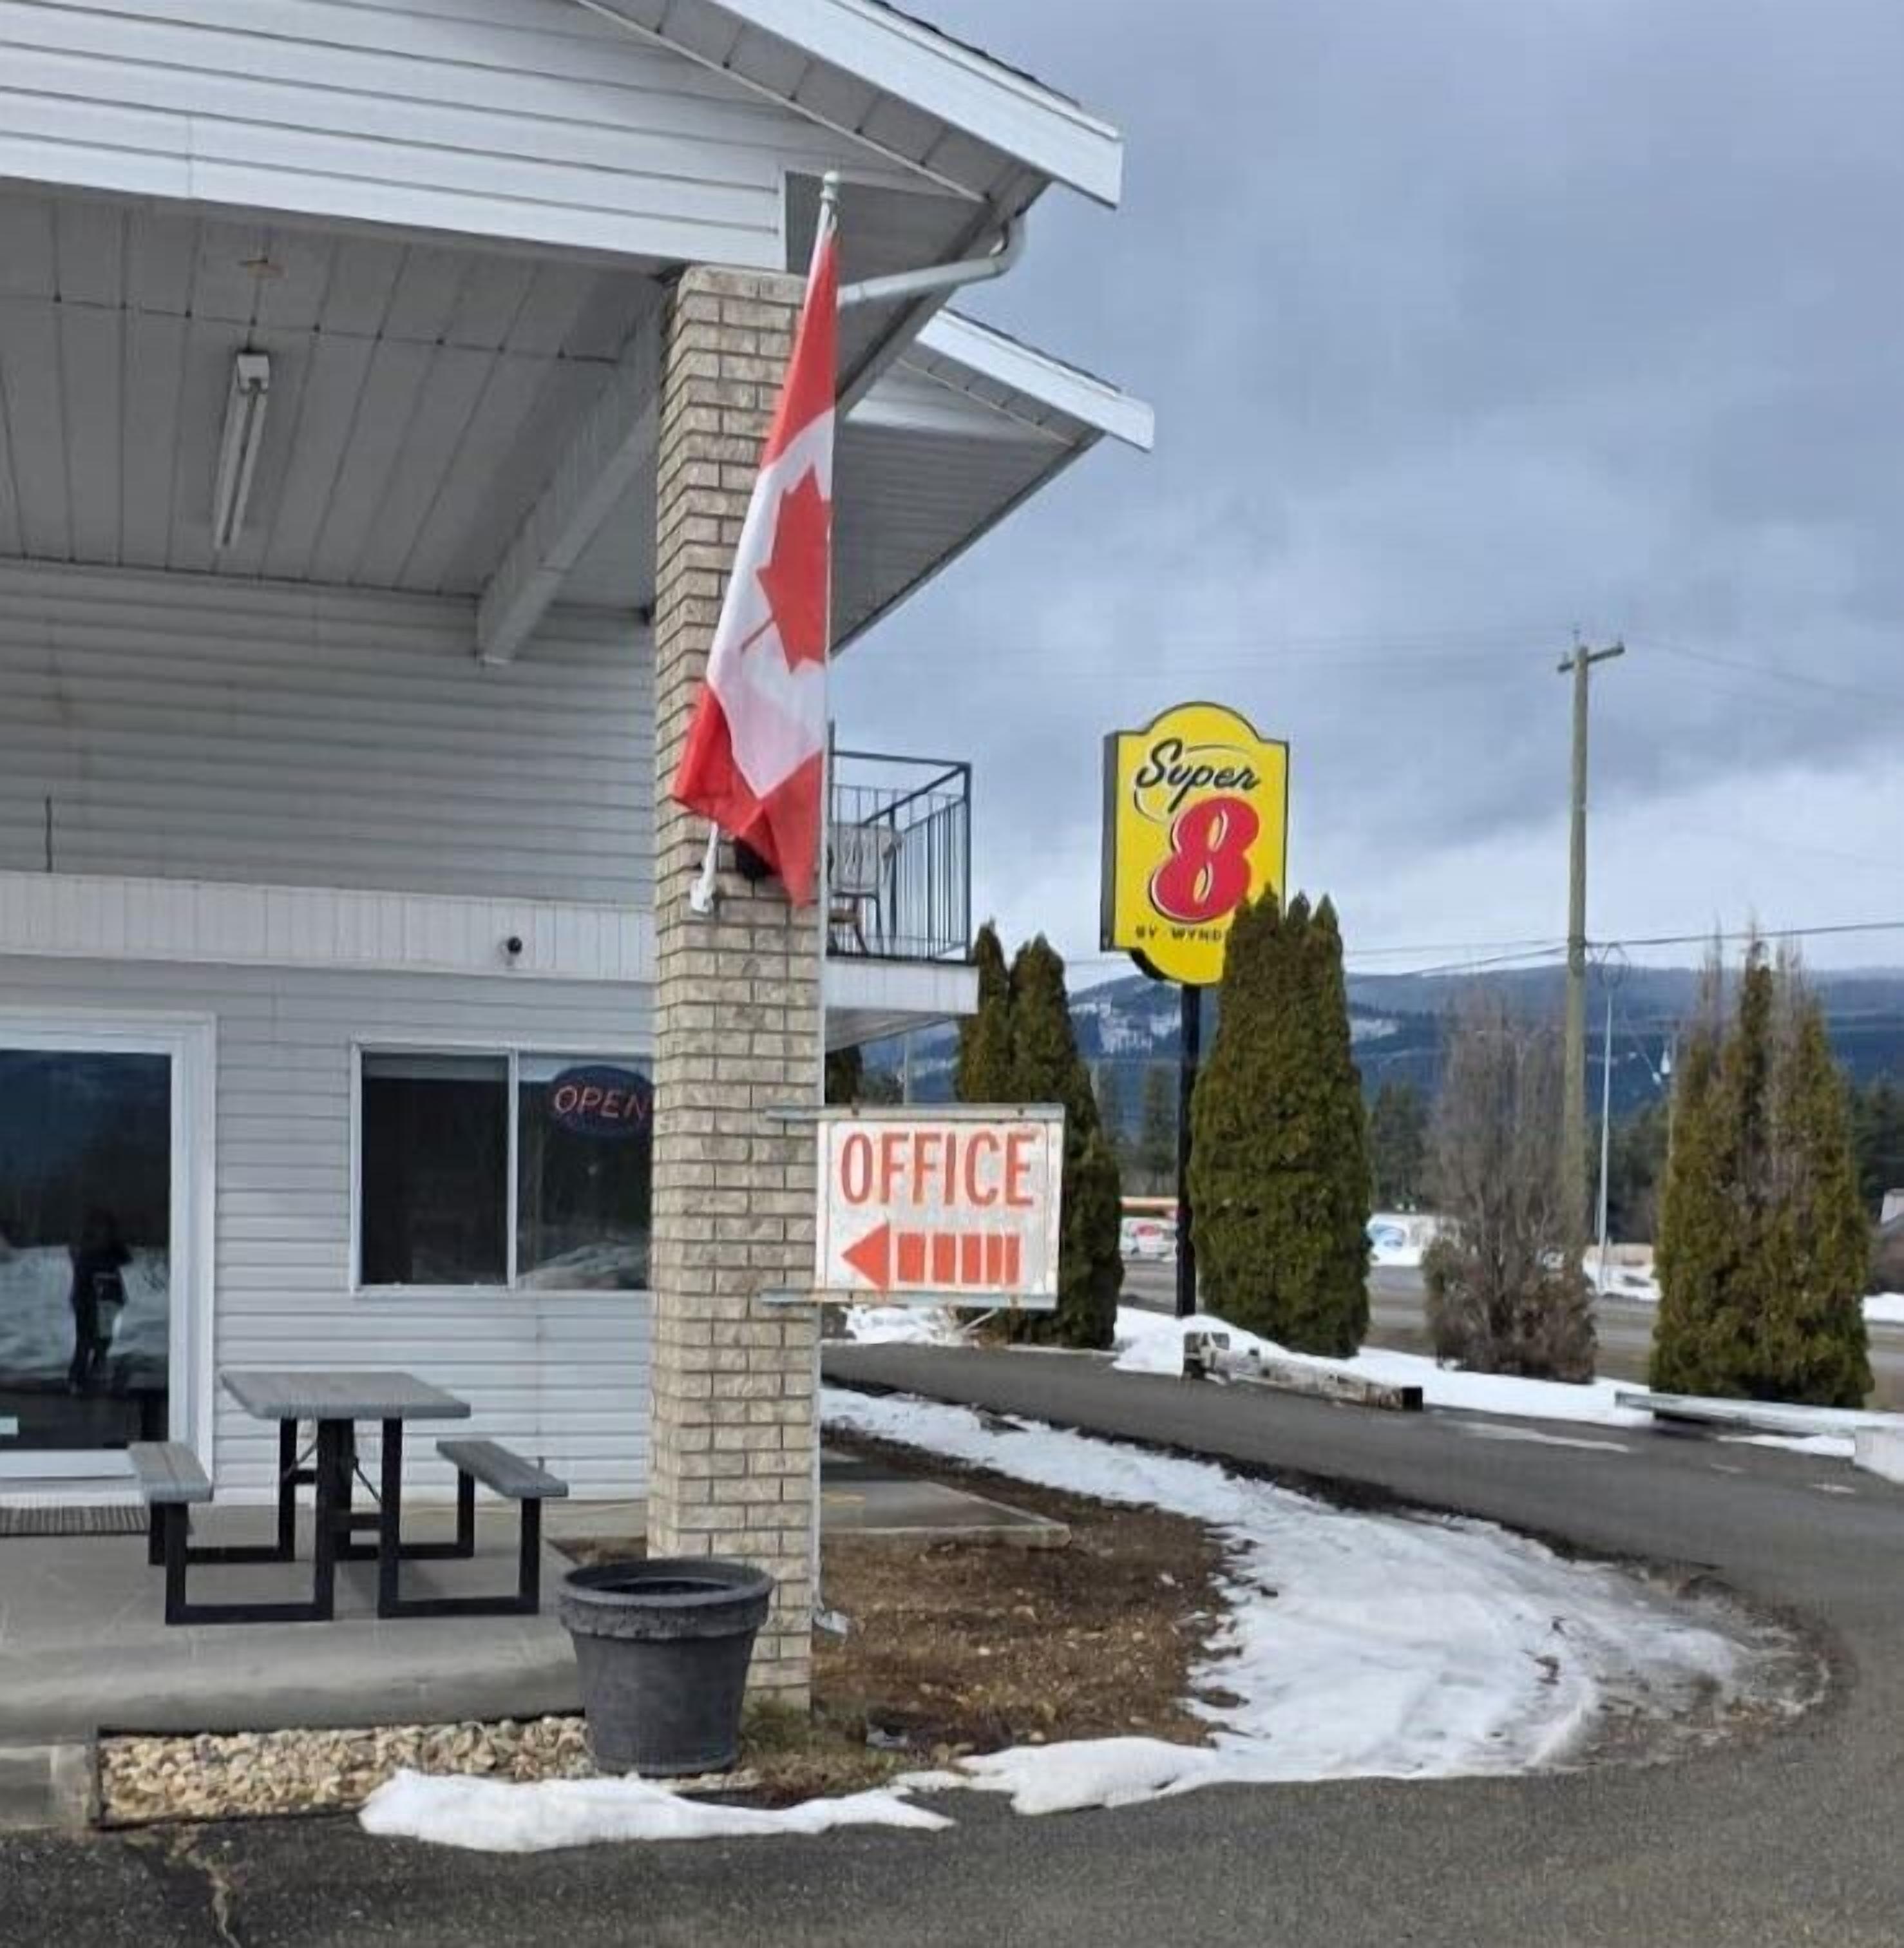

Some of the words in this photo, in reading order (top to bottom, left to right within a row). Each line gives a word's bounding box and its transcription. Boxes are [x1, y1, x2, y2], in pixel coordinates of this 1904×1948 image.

[1136, 738, 1261, 813] Super
[1149, 797, 1259, 924] 8
[1172, 926, 1223, 941] WYND
[555, 1085, 651, 1120] OPEN
[841, 1131, 1038, 1206] OFFICE
